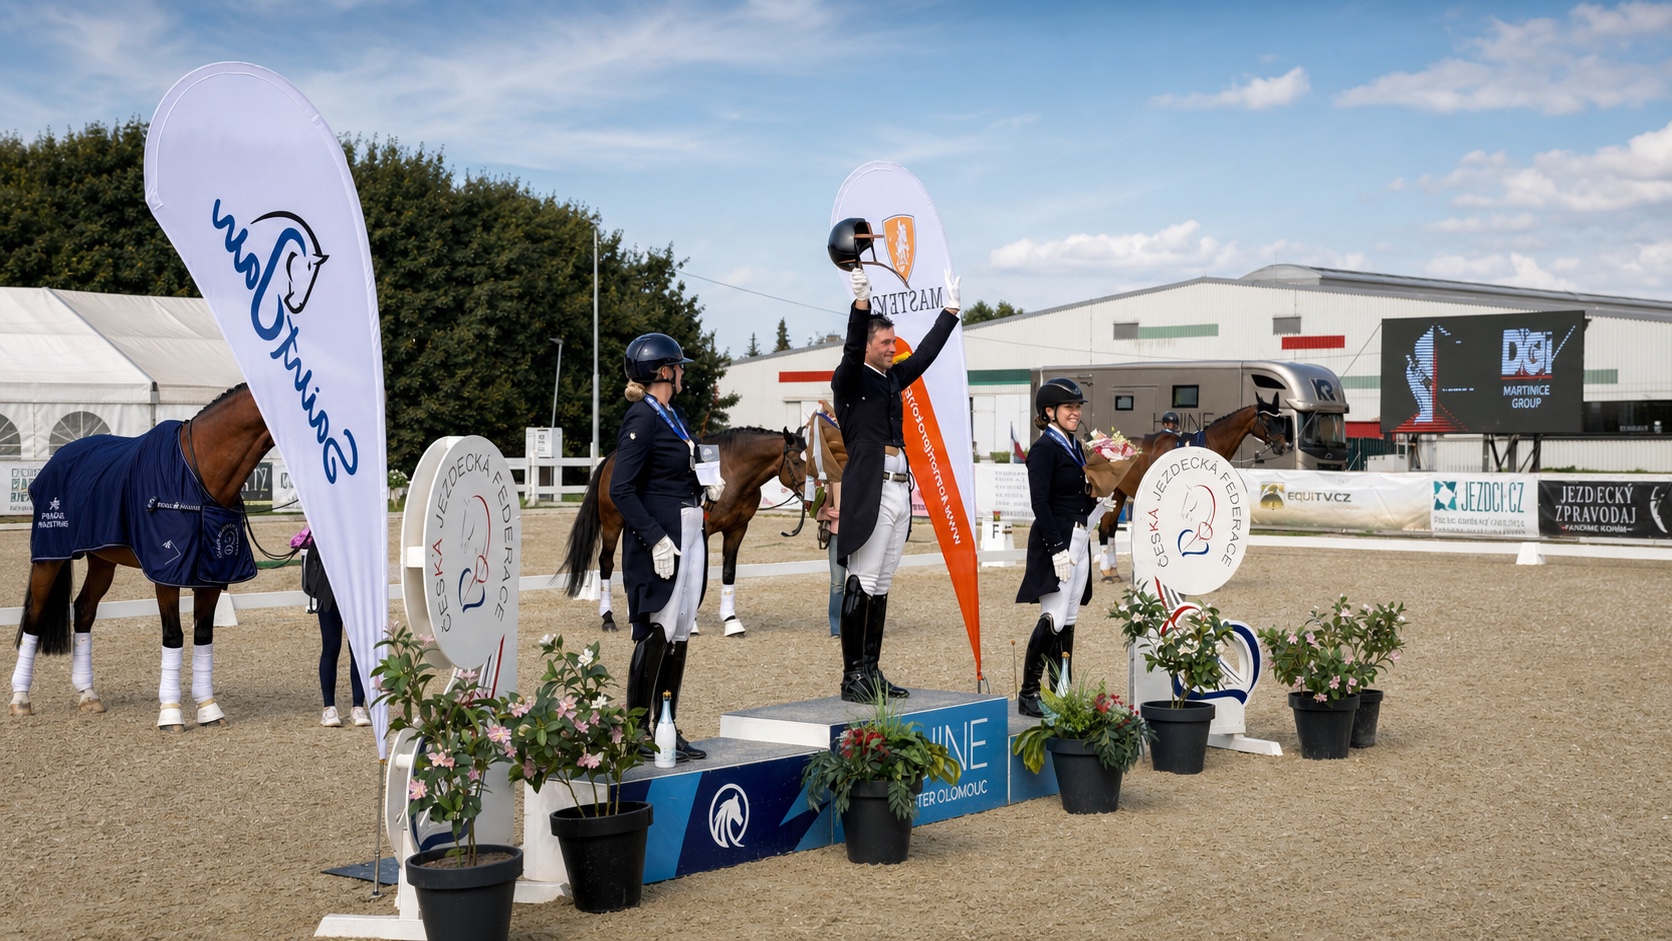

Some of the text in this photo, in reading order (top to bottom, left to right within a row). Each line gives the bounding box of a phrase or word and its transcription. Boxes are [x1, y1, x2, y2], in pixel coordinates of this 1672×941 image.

[1503, 385, 1550, 397] MARTINICE
[1511, 398, 1542, 409] GROUP
[1287, 491, 1351, 503] EQUITV.CZ
[1461, 481, 1525, 513] JEZDCI.CZ
[1560, 483, 1634, 504] JEZDECKÝ
[1153, 456, 1219, 501] JEZDECKÁ
[1219, 472, 1242, 567] FEDERACE
[1555, 505, 1636, 524] ZPRAVODAJ
[435, 453, 491, 529] JEZDECKÁ
[492, 471, 514, 622] FEDERACE
[915, 779, 988, 808] TER OLOMOUC
